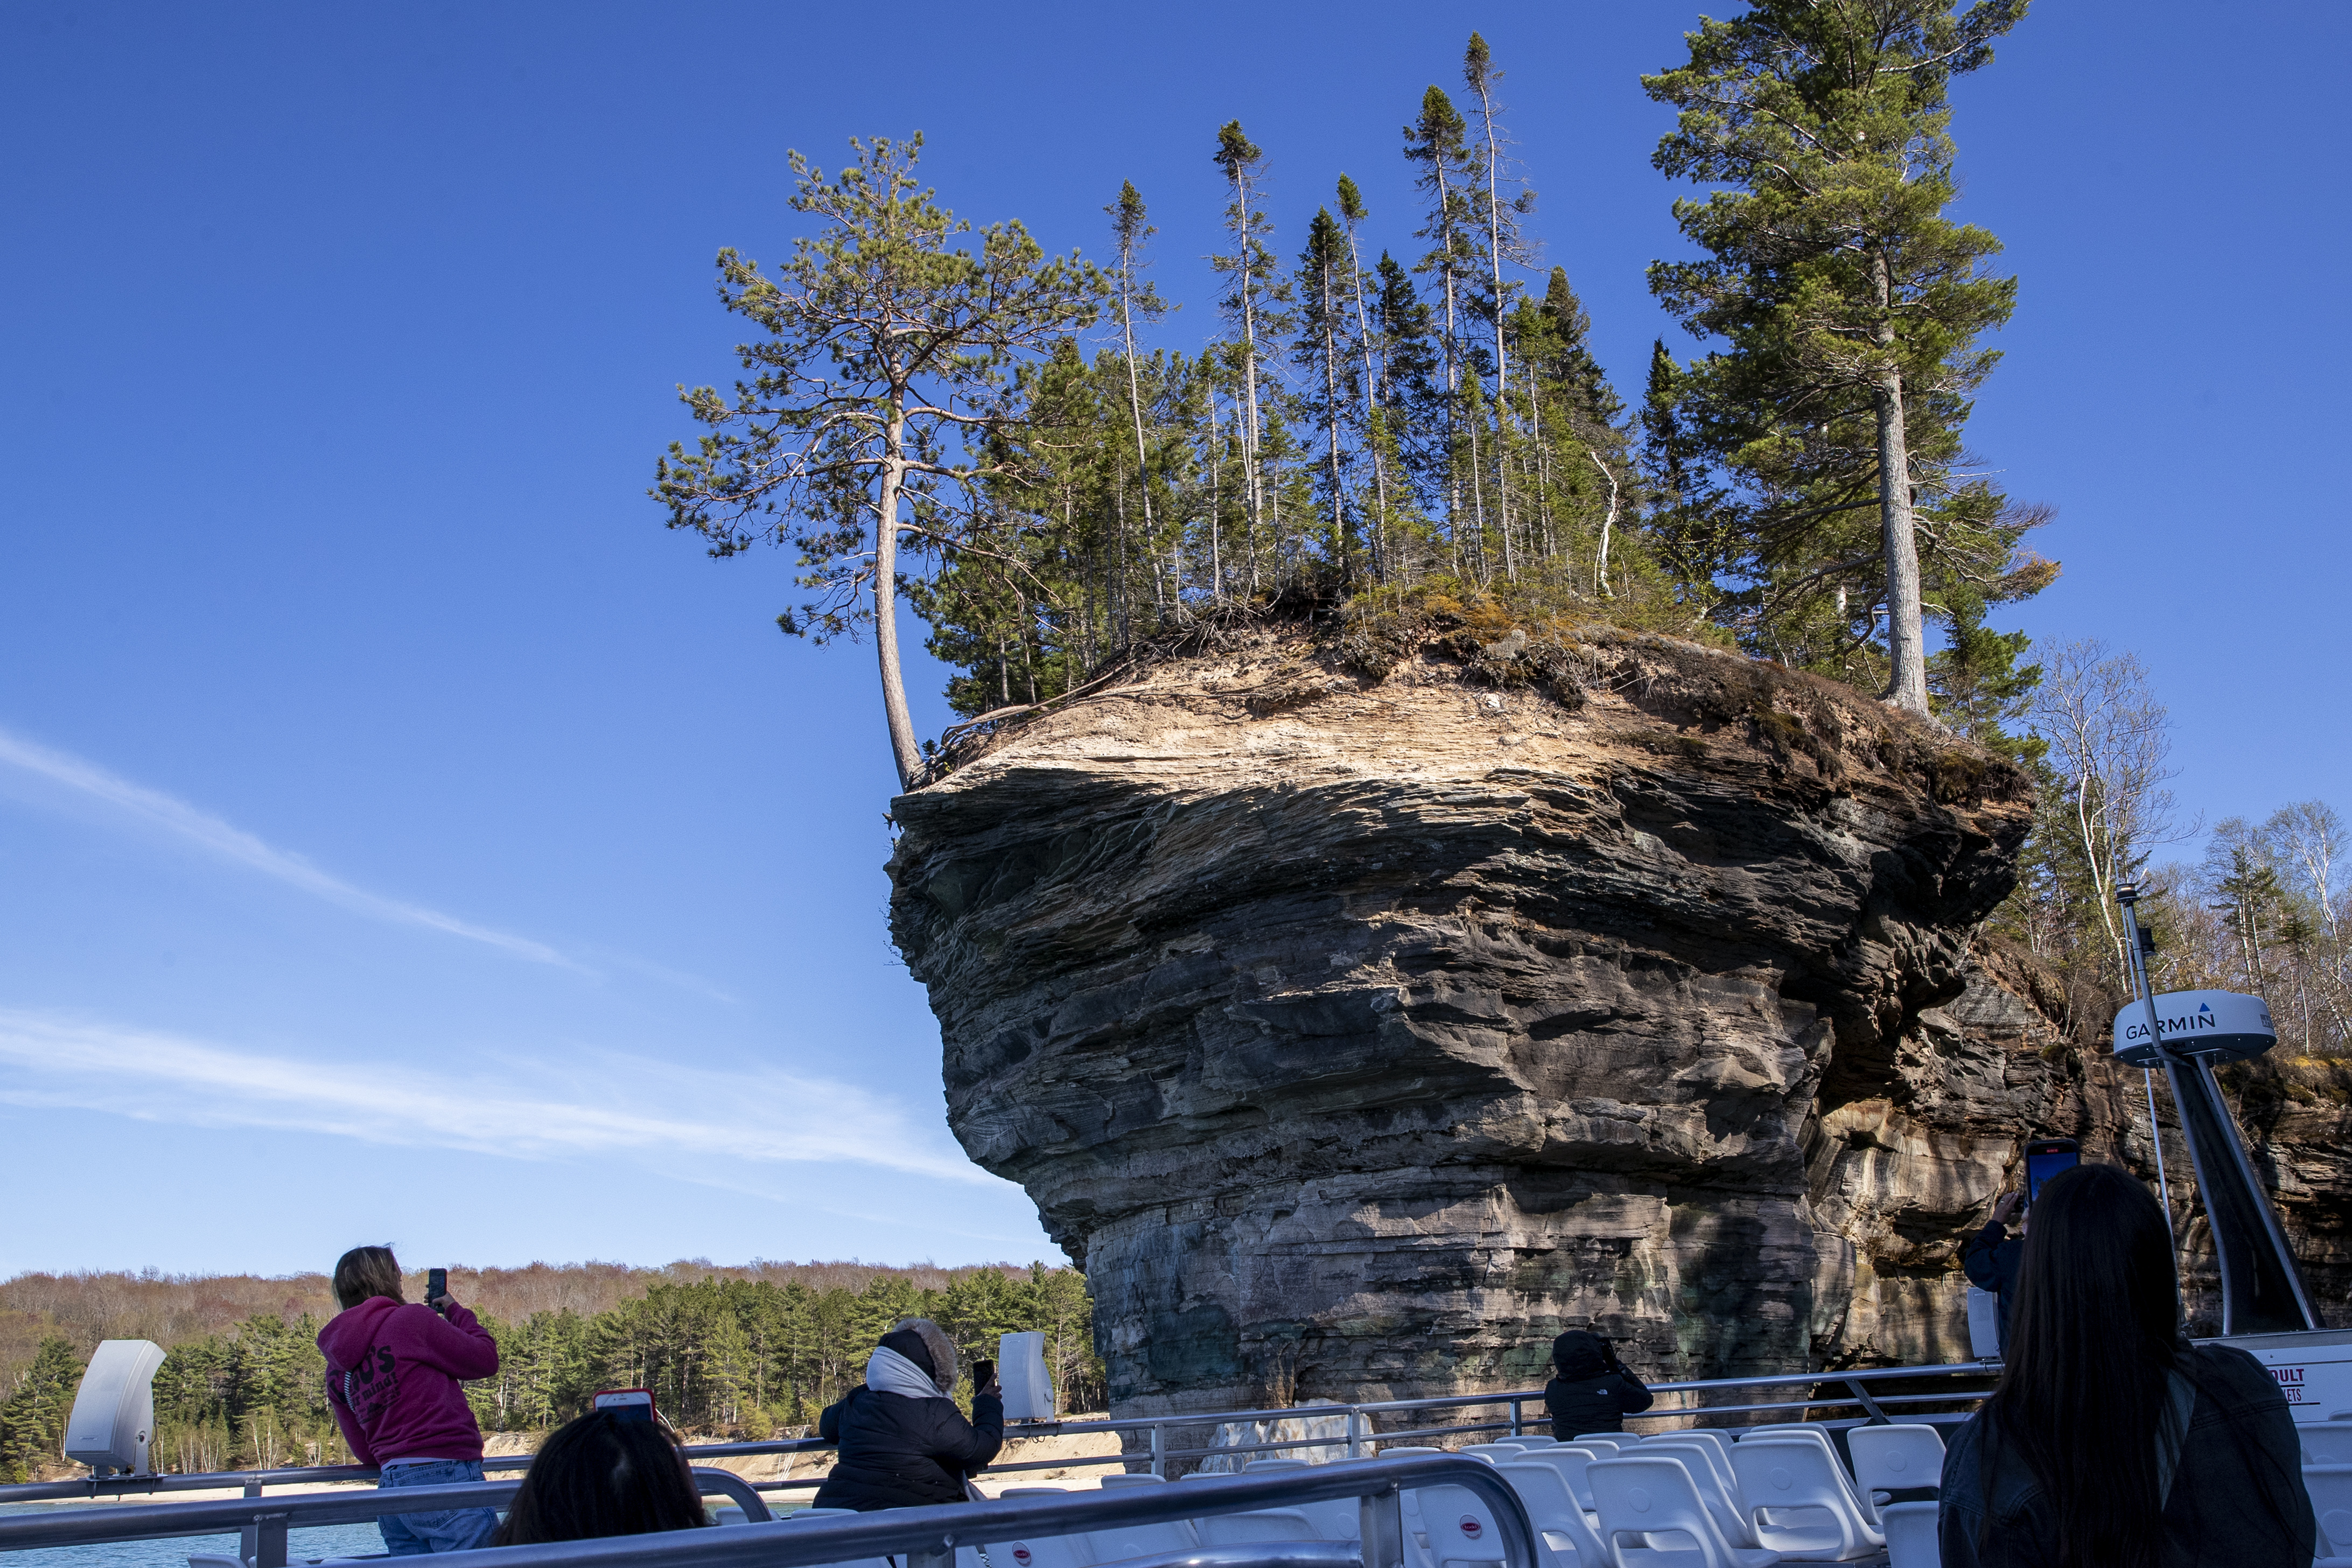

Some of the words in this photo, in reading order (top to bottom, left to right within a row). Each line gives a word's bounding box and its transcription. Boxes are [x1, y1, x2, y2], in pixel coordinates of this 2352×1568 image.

[2126, 1014, 2216, 1040] GARMIN
[2262, 1016, 2273, 1028] xH
[2268, 1368, 2304, 1382] DULT
[361, 1371, 399, 1401] mind!
